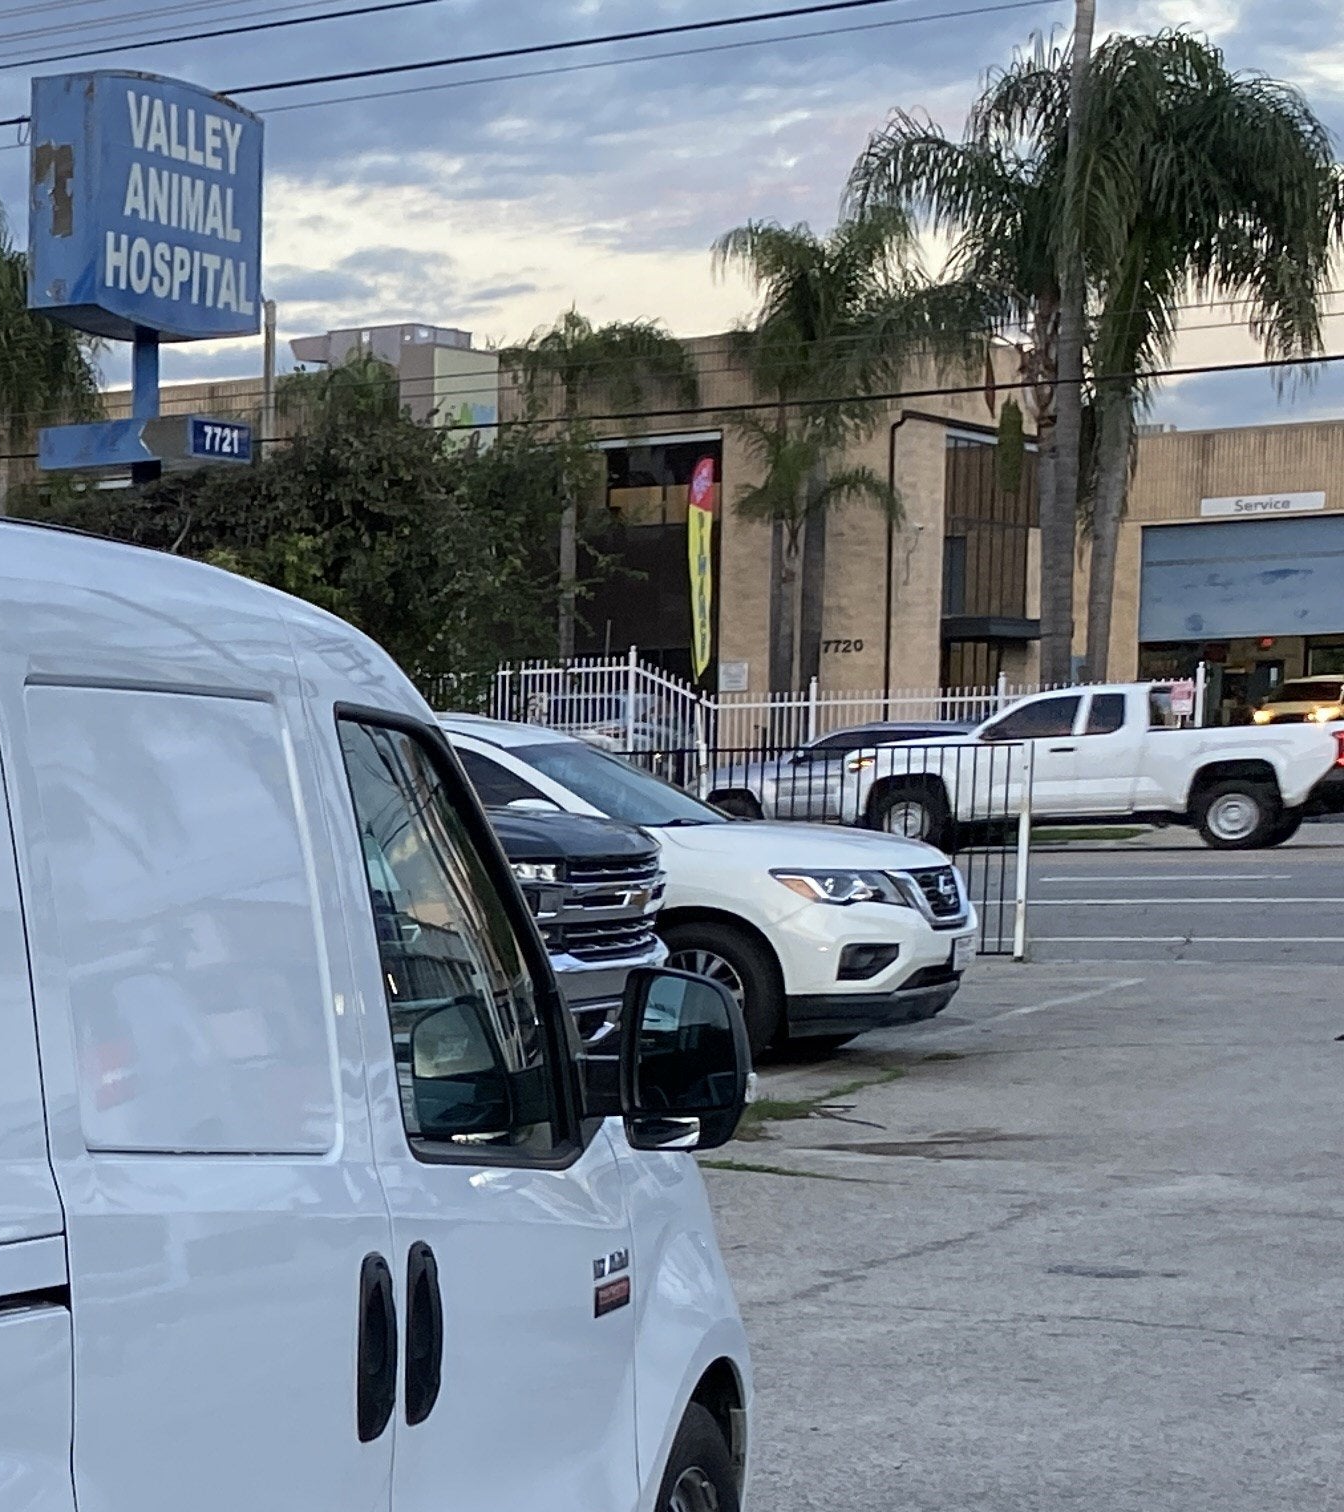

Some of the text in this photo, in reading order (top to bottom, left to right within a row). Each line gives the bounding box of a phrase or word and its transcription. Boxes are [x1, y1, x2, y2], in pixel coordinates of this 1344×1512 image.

[127, 90, 243, 175] VALLEY
[123, 162, 242, 243] ANIMAL
[105, 231, 254, 316] HOSPITAL
[204, 425, 239, 454] 7721
[1234, 497, 1291, 512] Service
[822, 639, 864, 654] 7720
